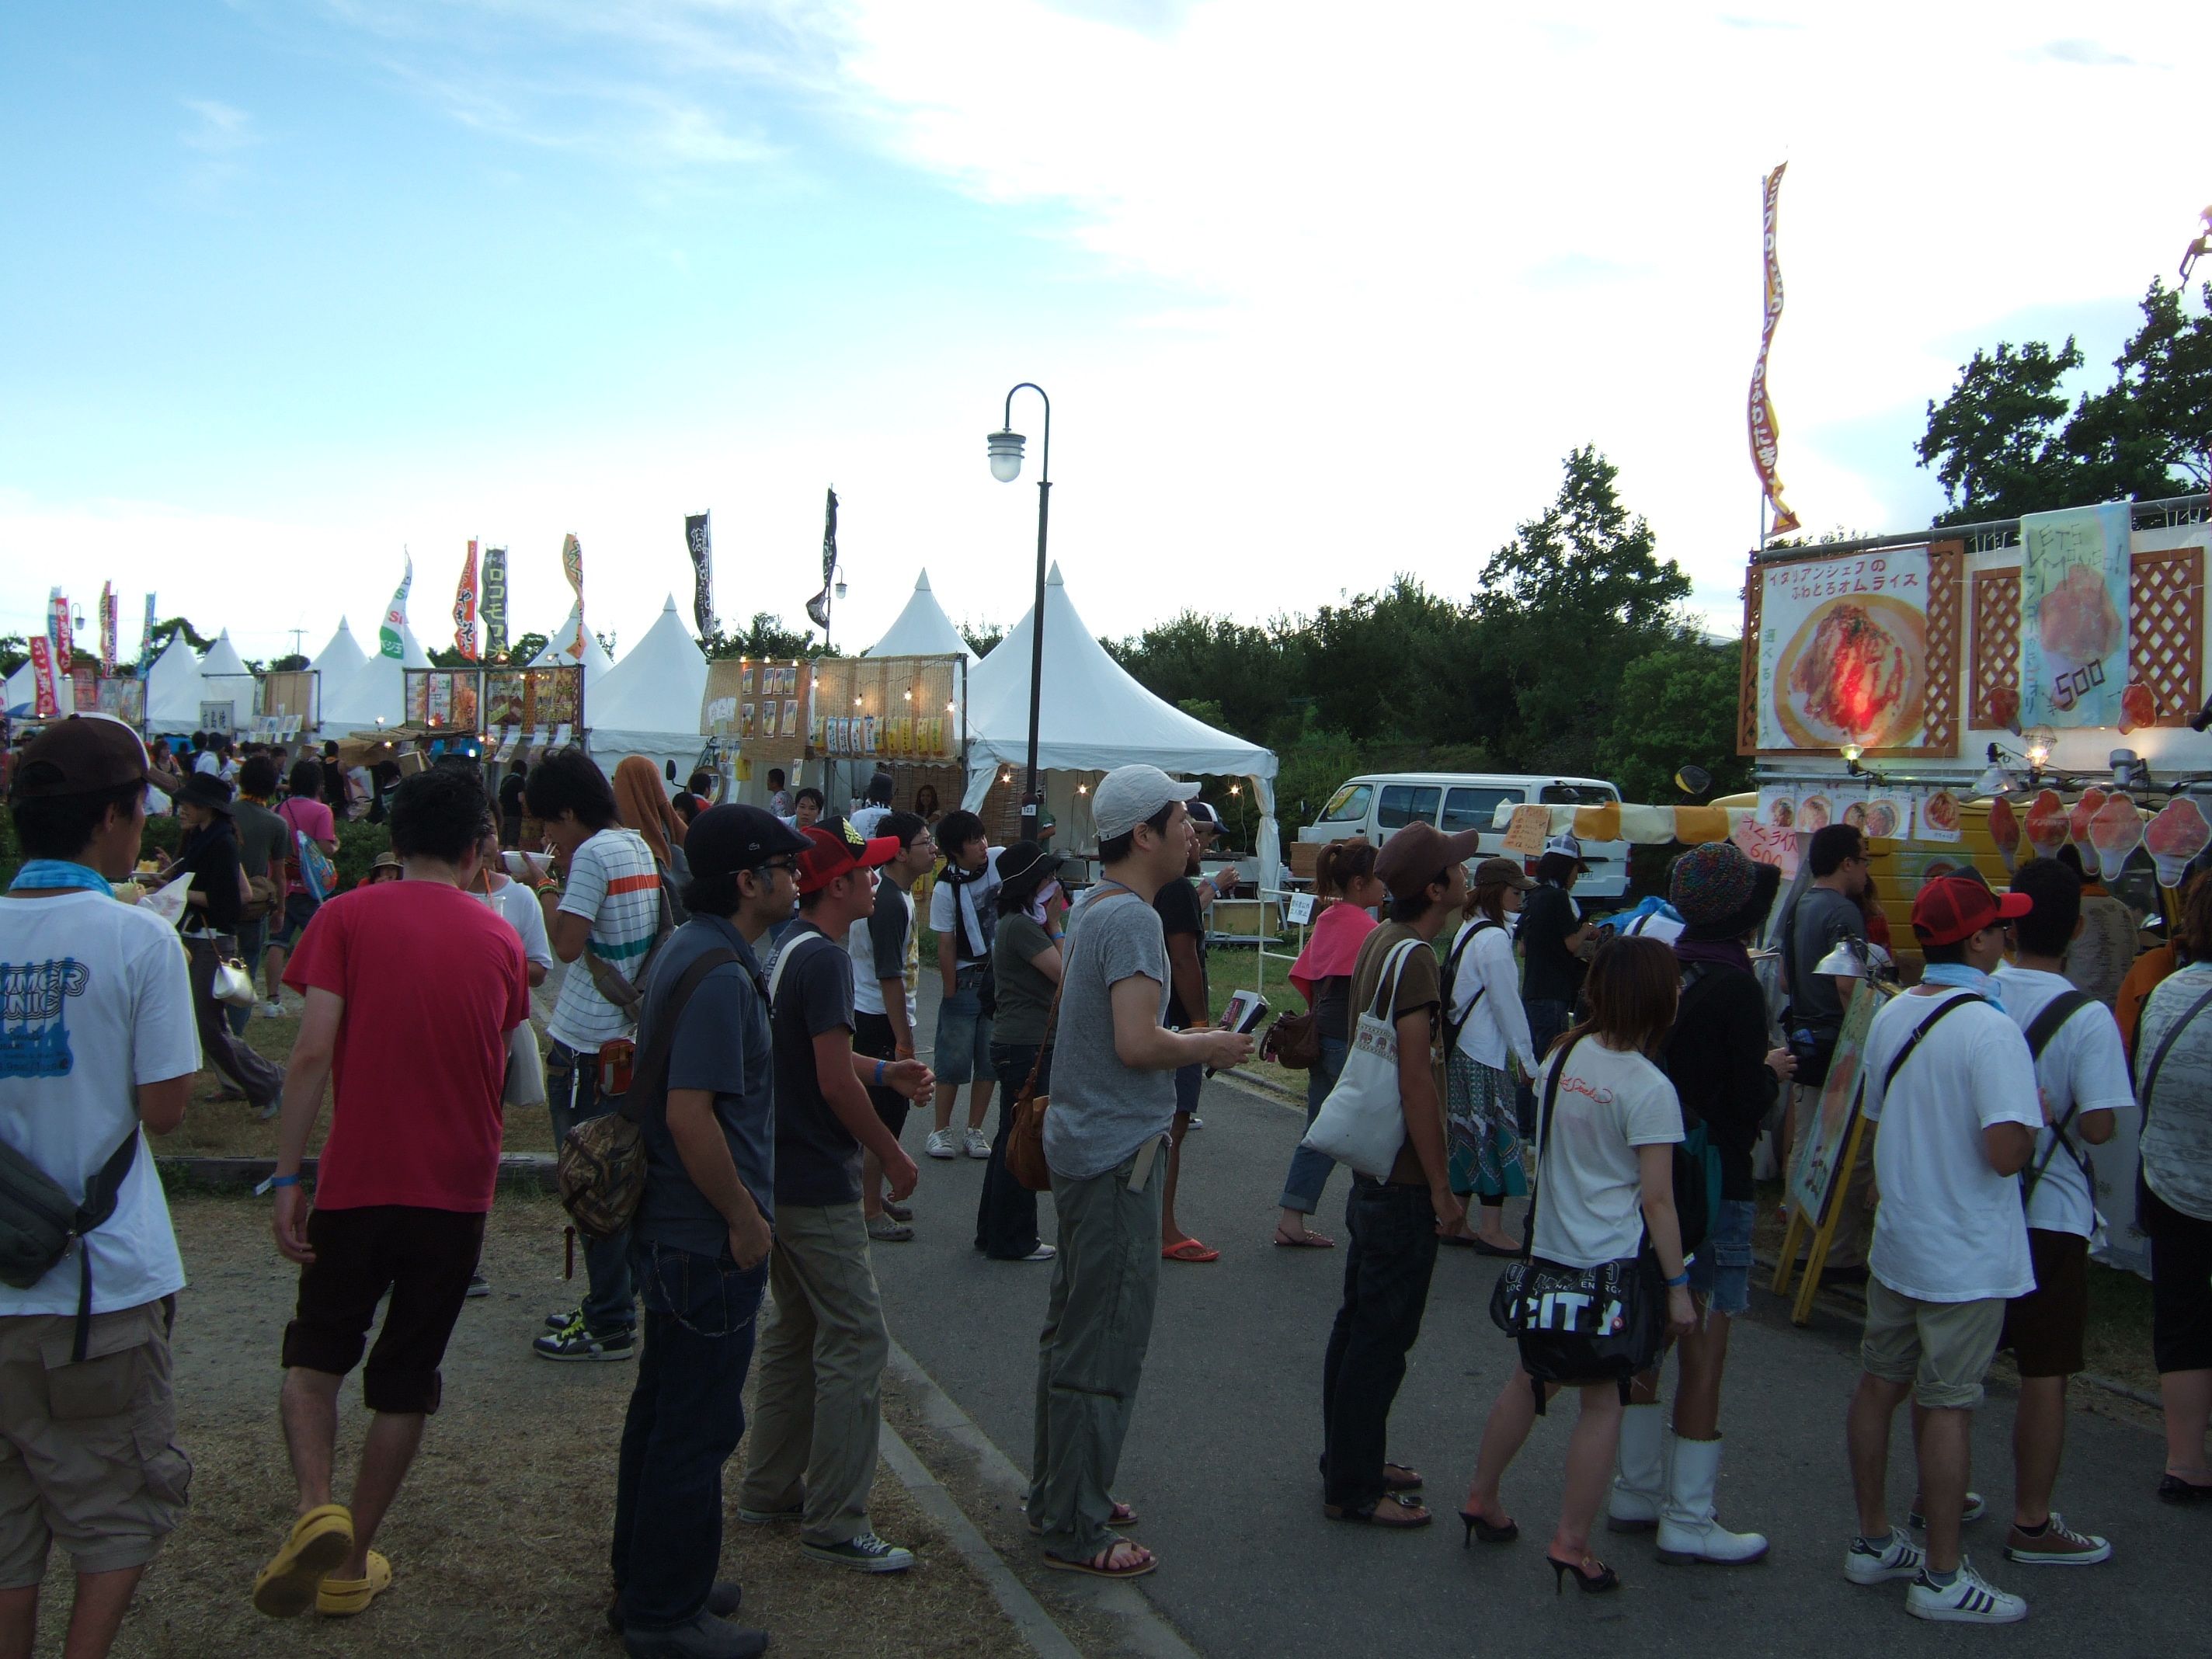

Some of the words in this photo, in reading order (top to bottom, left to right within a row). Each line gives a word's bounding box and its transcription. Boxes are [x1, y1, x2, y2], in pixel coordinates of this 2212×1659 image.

[1769, 558, 1887, 586] イタリアンシェフの
[1791, 572, 1918, 600] ふわとろオムライス
